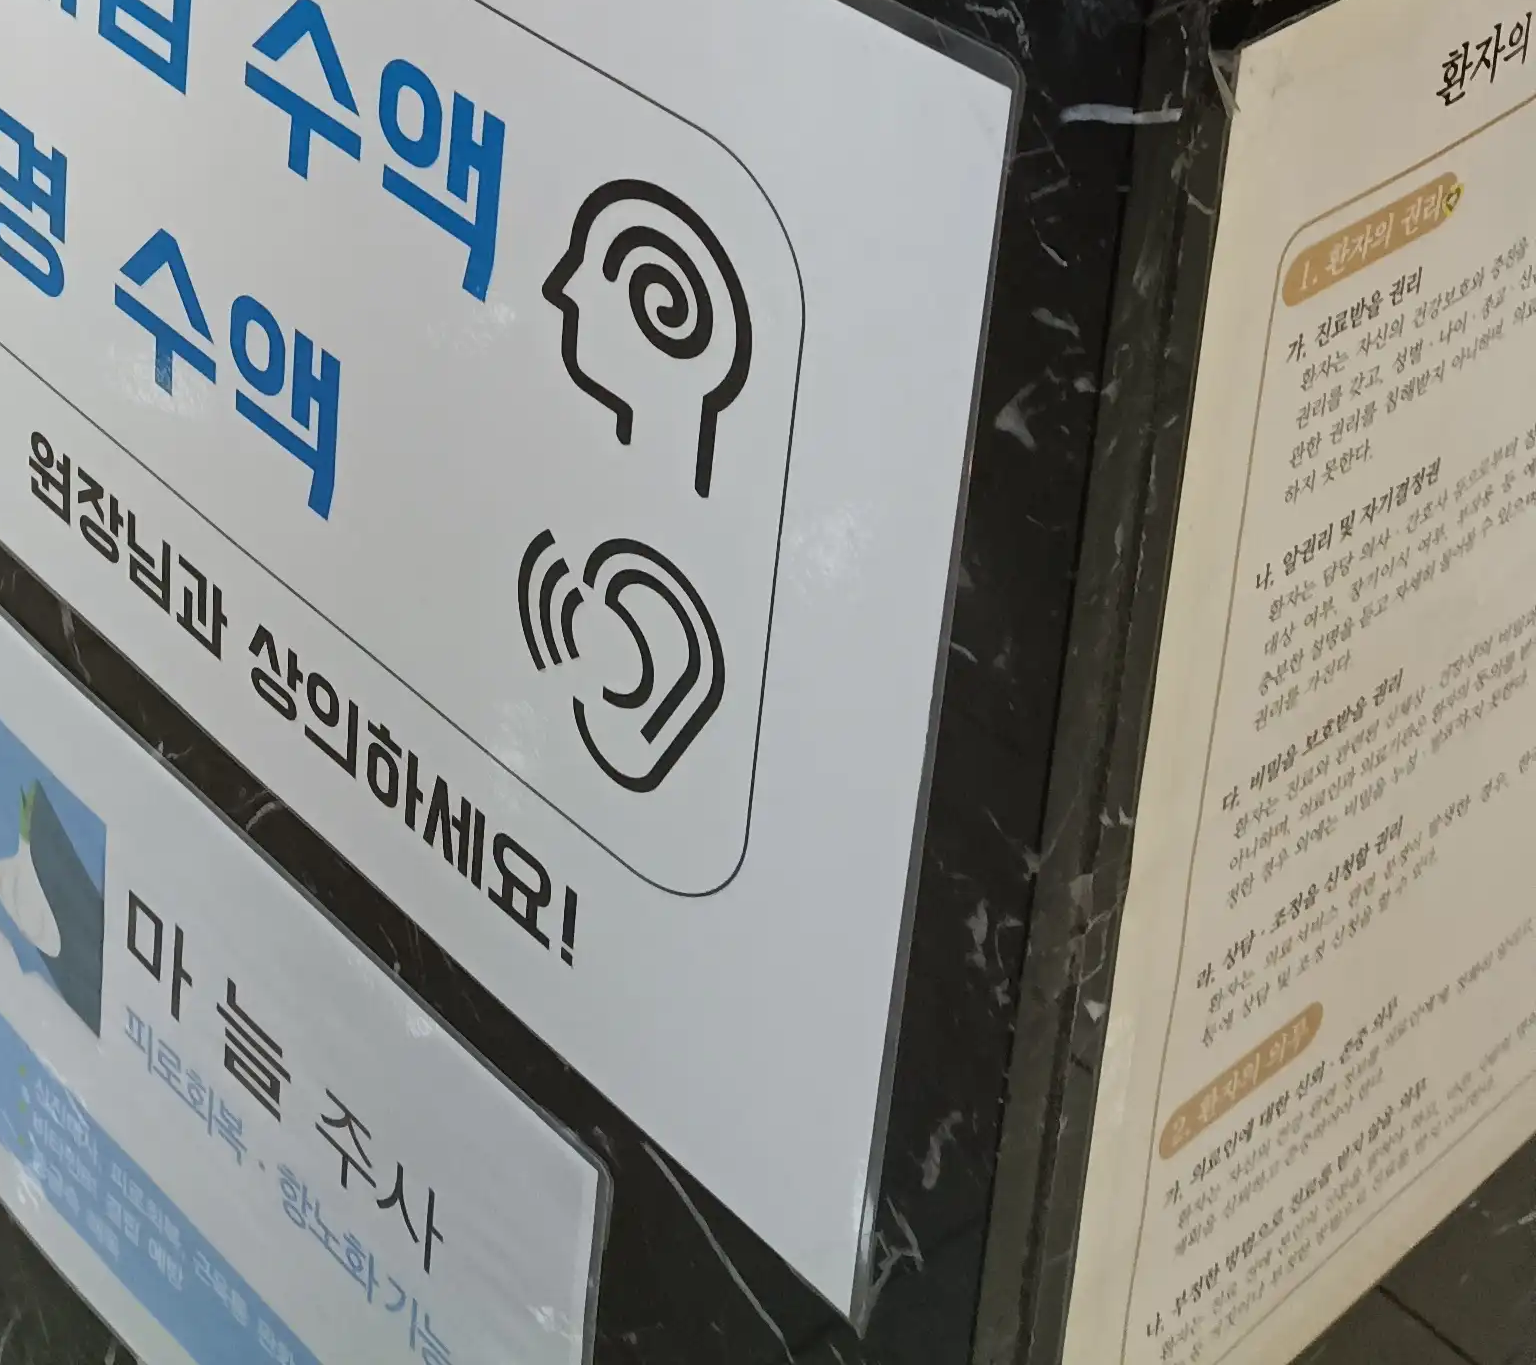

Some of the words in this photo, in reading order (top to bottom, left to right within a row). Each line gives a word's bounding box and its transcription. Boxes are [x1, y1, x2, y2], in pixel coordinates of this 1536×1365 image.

[1436, 13, 1530, 103] 환자의
[1325, 213, 1394, 278] 환자의
[1400, 185, 1443, 236] 권리
[1315, 289, 1383, 348] 진료받을
[1388, 266, 1423, 308] 권리
[1355, 314, 1404, 359] 자신의
[112, 226, 344, 523] 수액
[1281, 523, 1333, 575] 알권리
[1338, 510, 1355, 541] 및
[1359, 458, 1440, 526] 자기결정권
[24, 429, 231, 662] 원장님과
[247, 620, 582, 969] 상의하세요!
[1371, 667, 1404, 708] 권리
[123, 1002, 250, 1169] 피로회복
[275, 1160, 452, 1365] 항노화기능
